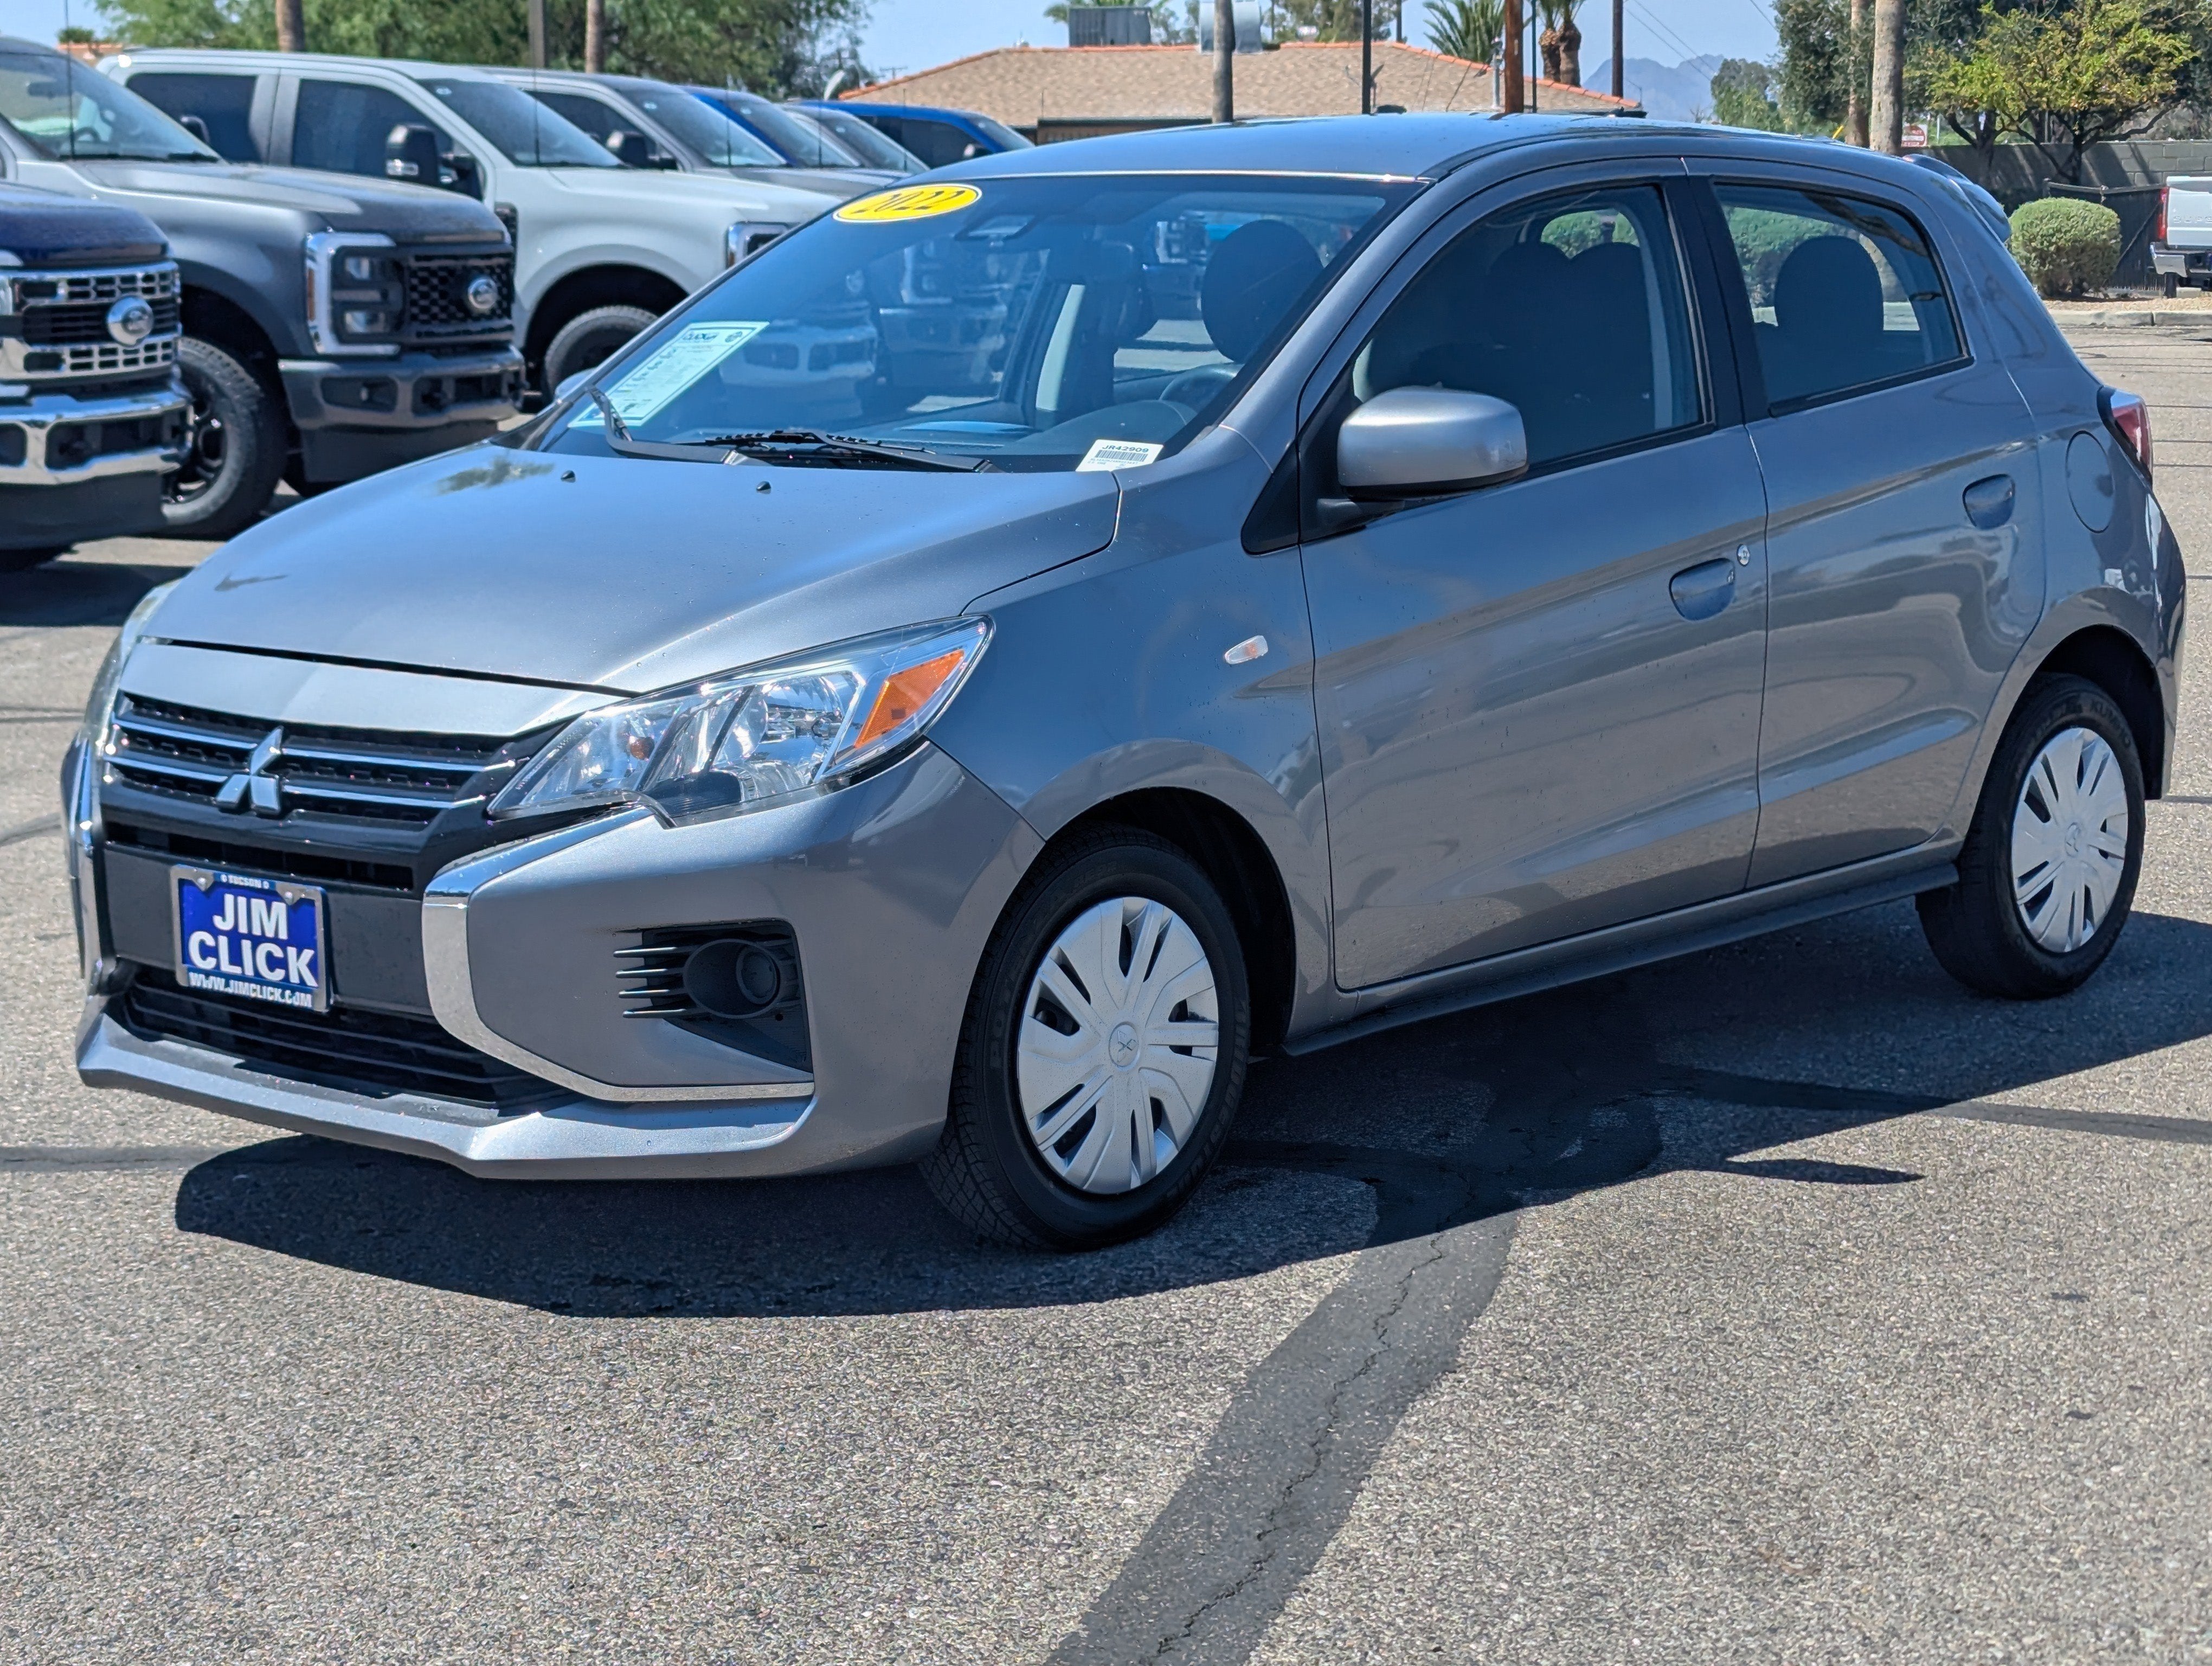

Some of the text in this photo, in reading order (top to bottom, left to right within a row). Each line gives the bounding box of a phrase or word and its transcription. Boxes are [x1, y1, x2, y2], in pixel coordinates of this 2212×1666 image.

[851, 190, 966, 214] 2022
[1102, 445, 1149, 453] JR42909
[212, 893, 288, 940] JIM
[188, 931, 319, 987] CLICK
[188, 971, 313, 1008] WWW.JIMCLICK.COM
